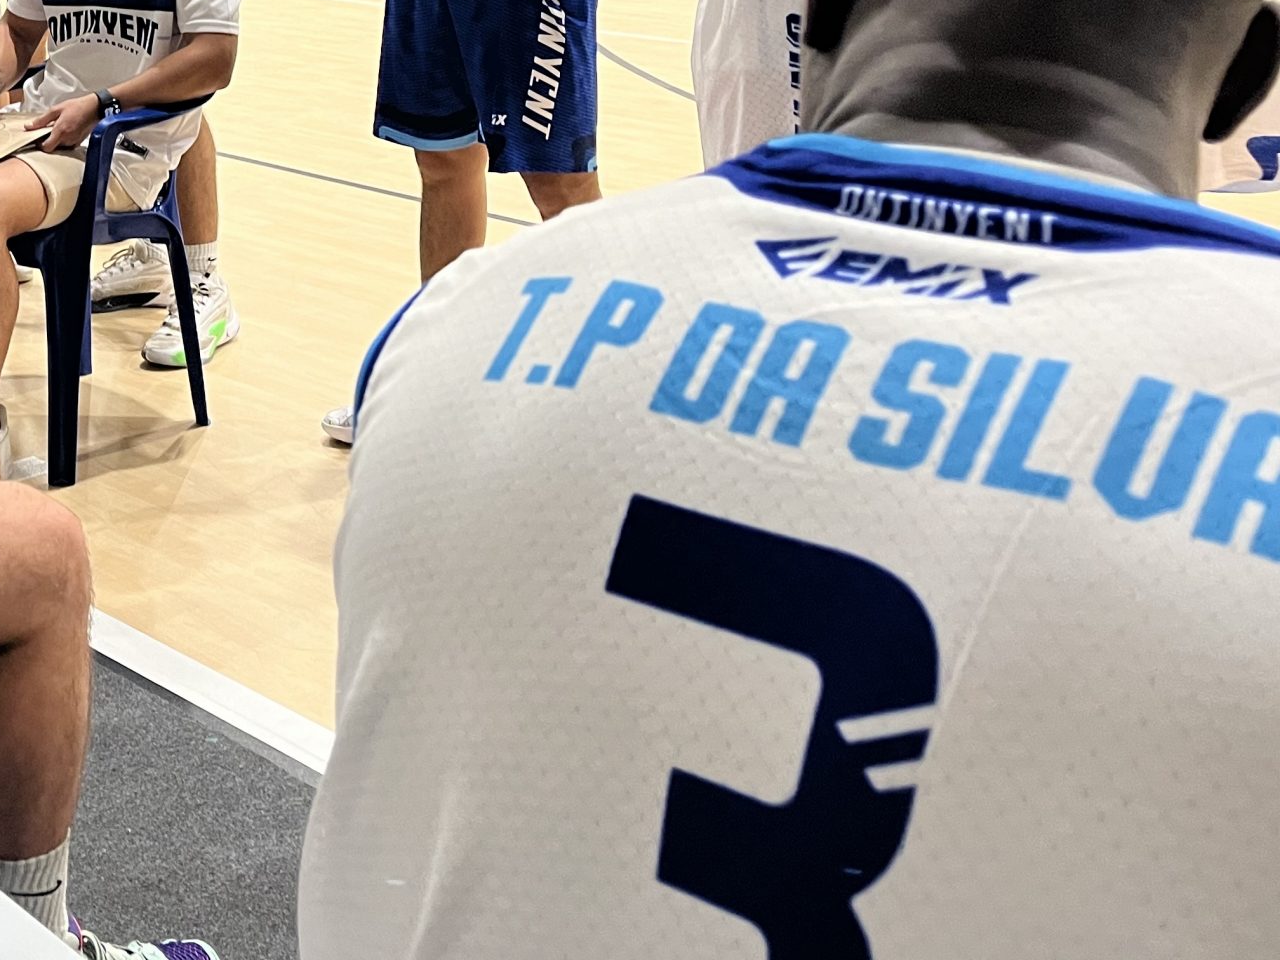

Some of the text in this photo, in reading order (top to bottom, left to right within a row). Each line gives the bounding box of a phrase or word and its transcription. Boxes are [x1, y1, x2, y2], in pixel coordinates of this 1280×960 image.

[48, 9, 159, 57] ONTINYENT
[836, 185, 1058, 244] ONTINYENT
[483, 276, 664, 390] T.P
[647, 301, 851, 447] DA
[604, 493, 940, 960] 3
